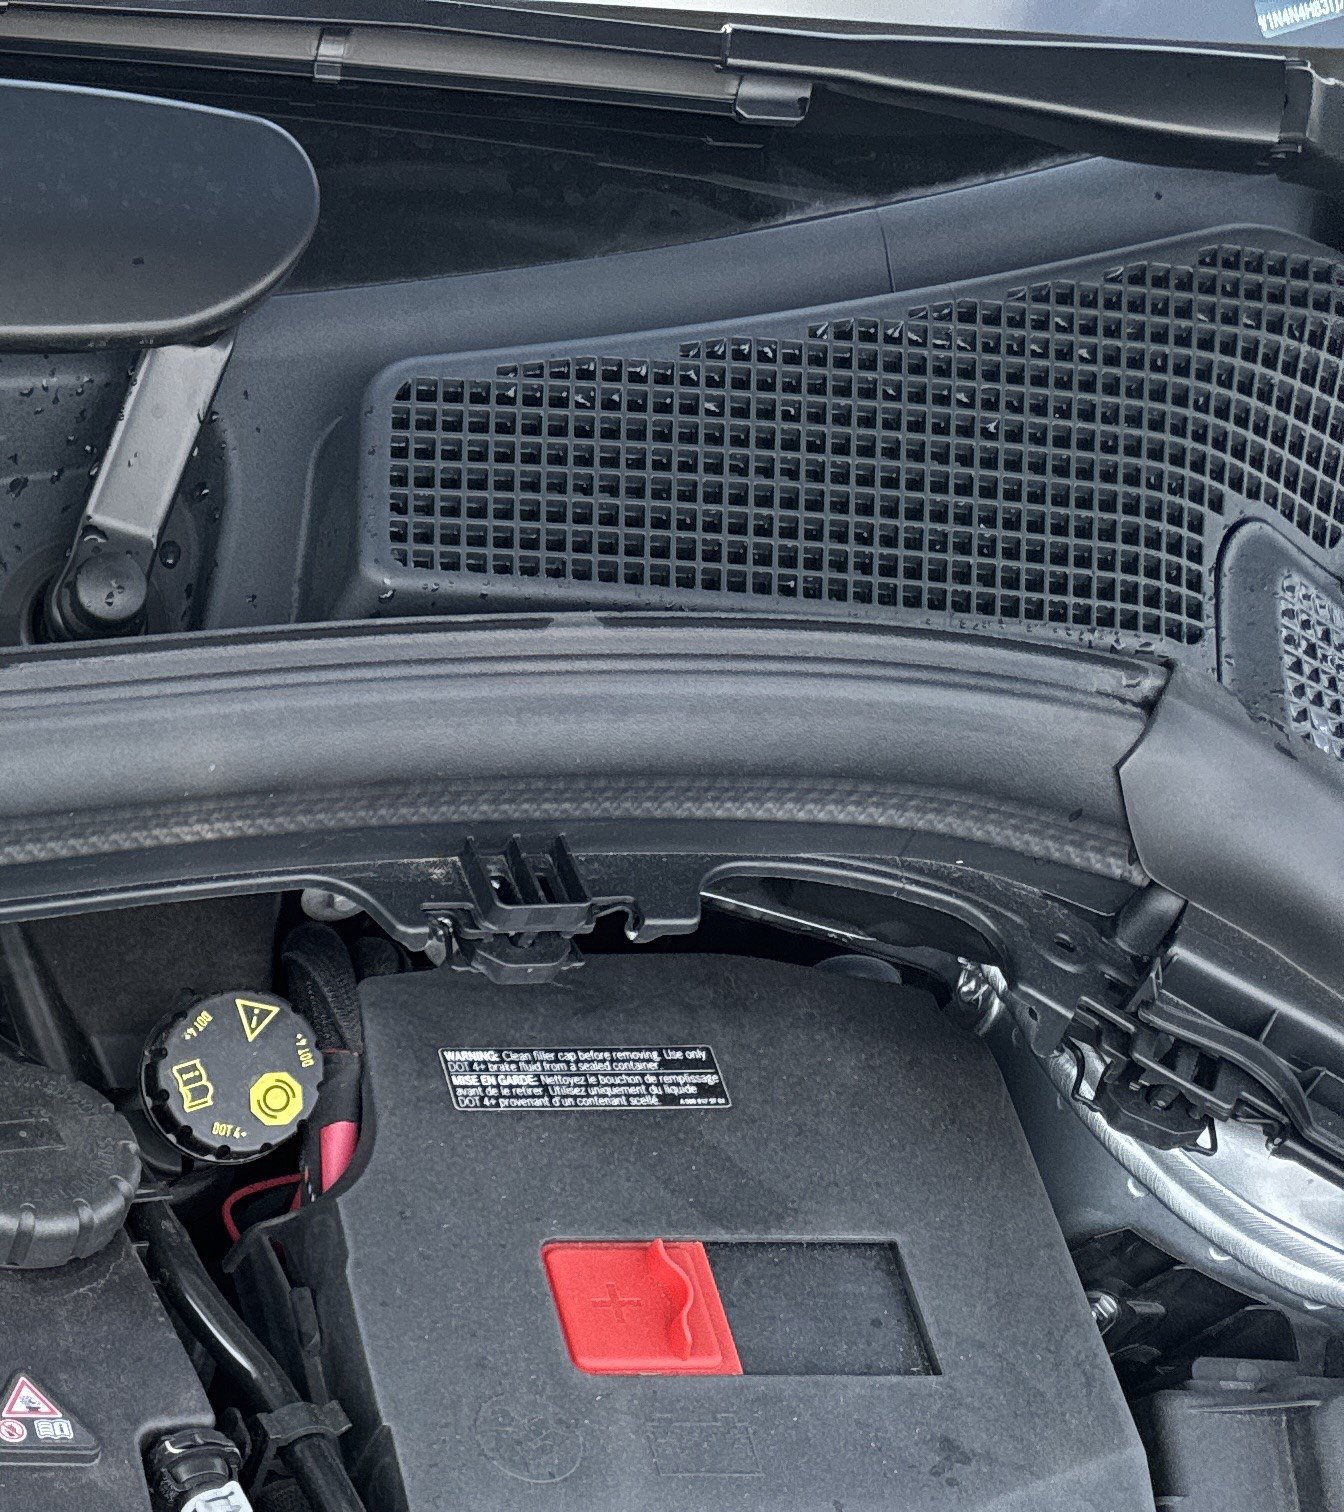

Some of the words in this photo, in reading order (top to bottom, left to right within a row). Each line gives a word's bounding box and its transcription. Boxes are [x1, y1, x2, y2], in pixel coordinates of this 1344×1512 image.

[443, 1051, 500, 1061] WARNING:
[502, 1051, 532, 1061] Clean
[533, 1051, 556, 1061] filler
[557, 1052, 576, 1063] cap
[577, 1050, 611, 1061] before
[612, 1050, 661, 1062] removing.
[663, 1049, 683, 1060] Use
[685, 1049, 706, 1061] only
[447, 1062, 470, 1072] DOT
[472, 1062, 486, 1071] 4+
[487, 1062, 518, 1072] brake
[519, 1062, 542, 1072] fluid
[543, 1061, 568, 1071] from
[569, 1062, 577, 1071] a
[578, 1061, 611, 1071] sealed
[451, 1075, 480, 1086] MISE
[480, 1075, 497, 1086] EN
[497, 1075, 539, 1086] GARDE:
[540, 1075, 586, 1087] Nettoyez
[586, 1074, 598, 1084] le
[598, 1074, 643, 1085] bouchon
[644, 1074, 657, 1084] de
[658, 1074, 719, 1086] remplissage
[455, 1087, 484, 1096] avant
[485, 1086, 499, 1096] de
[500, 1086, 511, 1096] le
[548, 1085, 586, 1096] Utilisez
[588, 1085, 646, 1097] uniquement
[648, 1084, 662, 1095] du
[664, 1084, 698, 1096] liquide
[457, 1096, 480, 1107] DOT
[483, 1096, 497, 1107] 4+
[498, 1096, 551, 1109] provenant
[552, 1096, 575, 1107] d'un
[576, 1095, 627, 1106] contenant
[212, 1121, 234, 1137] DOT
